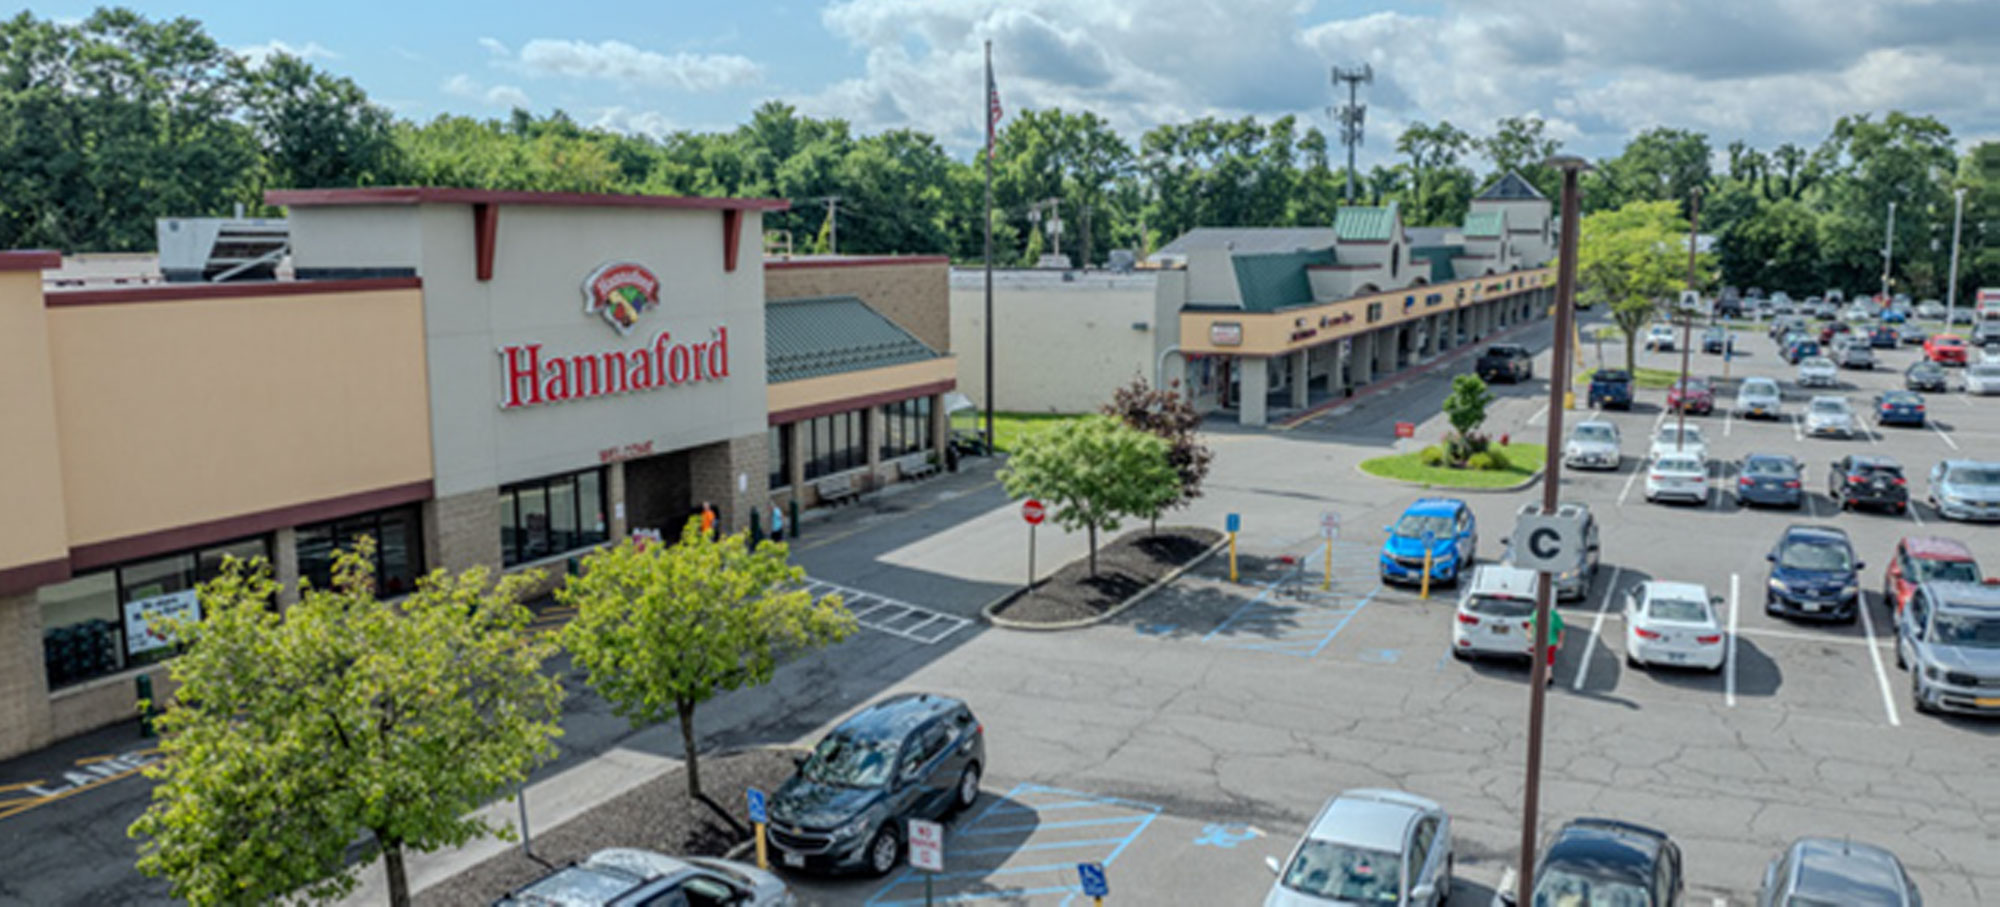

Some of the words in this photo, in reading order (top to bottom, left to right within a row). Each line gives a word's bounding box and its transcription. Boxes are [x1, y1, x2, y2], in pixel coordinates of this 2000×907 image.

[1684, 293, 1696, 305] A
[500, 325, 729, 408] Hannaford
[1528, 527, 1561, 560] C
